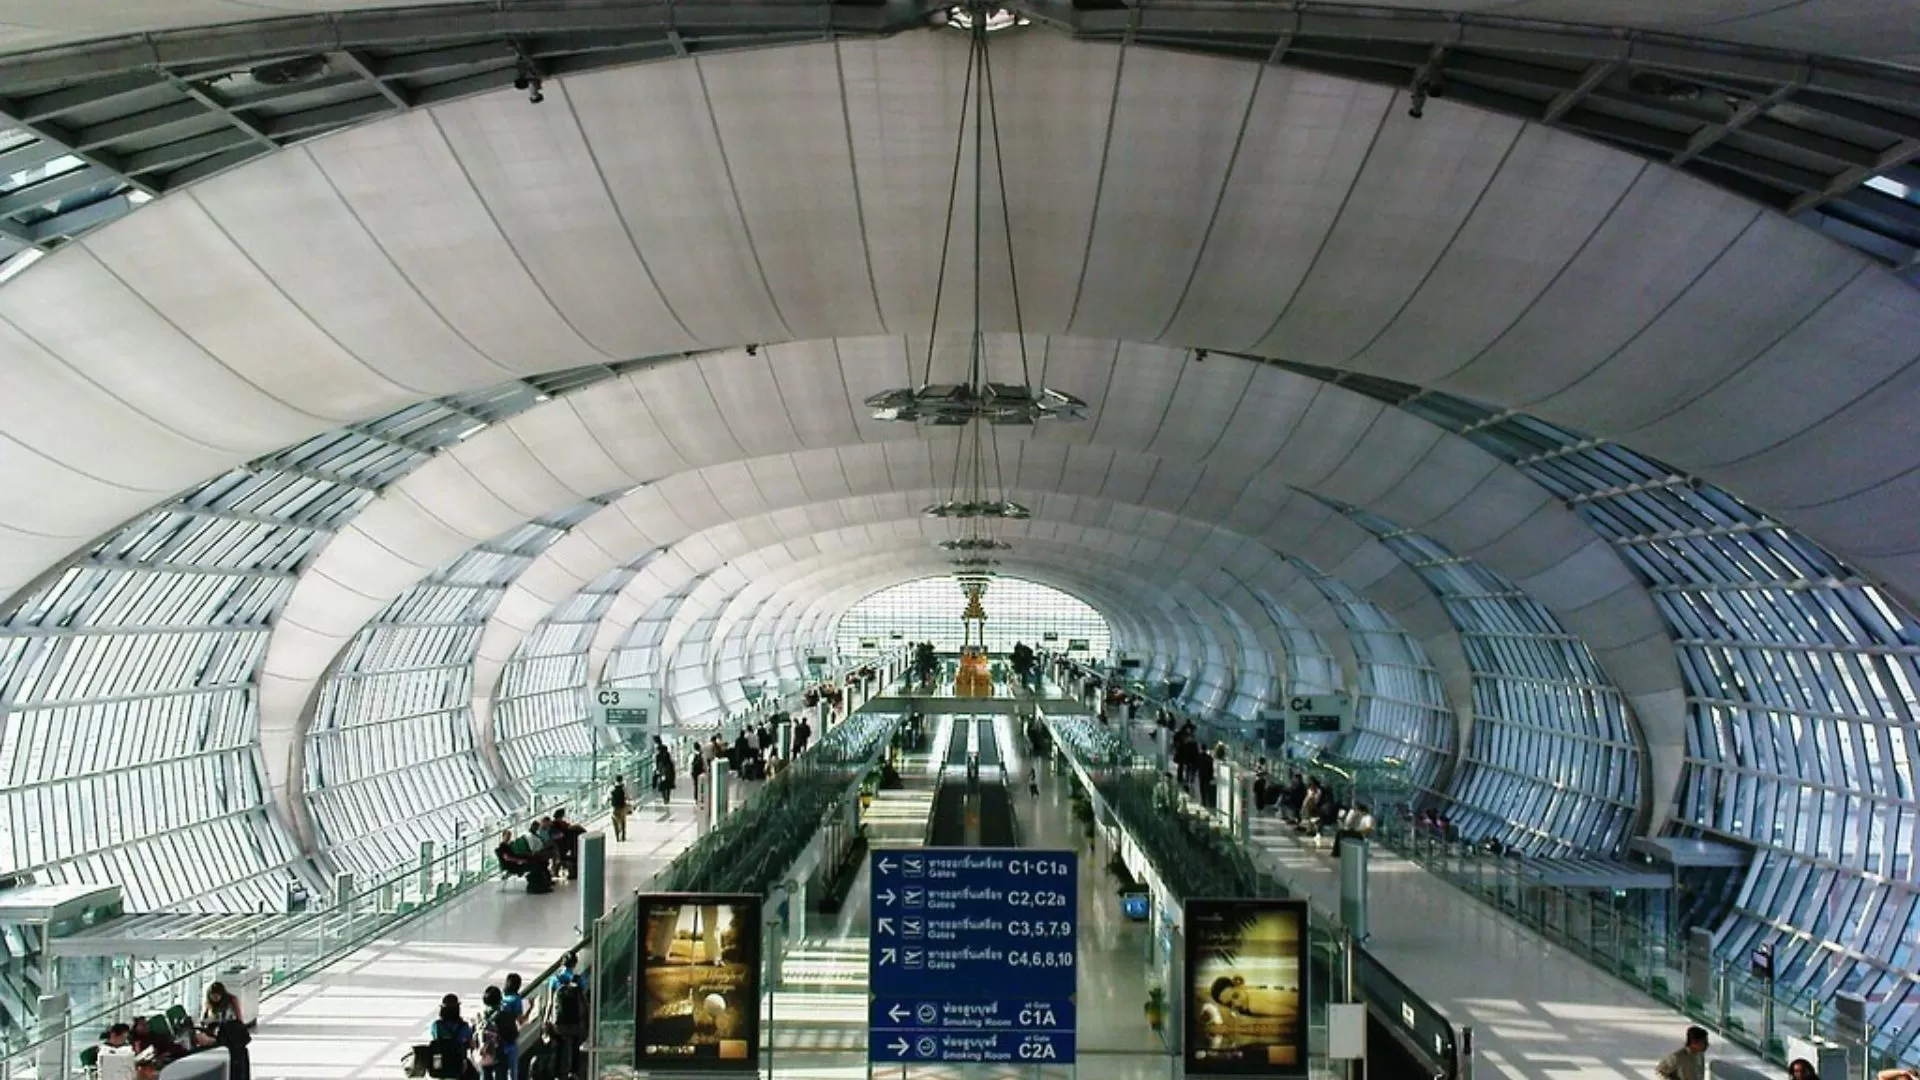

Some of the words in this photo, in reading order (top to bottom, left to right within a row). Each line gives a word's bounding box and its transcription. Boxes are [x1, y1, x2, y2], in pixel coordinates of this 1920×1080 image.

[598, 691, 620, 706] C3
[1291, 697, 1313, 712] C4
[943, 1018, 982, 1028] Smoking
[985, 1018, 1012, 1026] Room
[1019, 1010, 1056, 1026] C1A
[943, 1052, 982, 1061] Smoking
[985, 1052, 1011, 1060] Room
[1019, 1043, 1056, 1059] C2A
